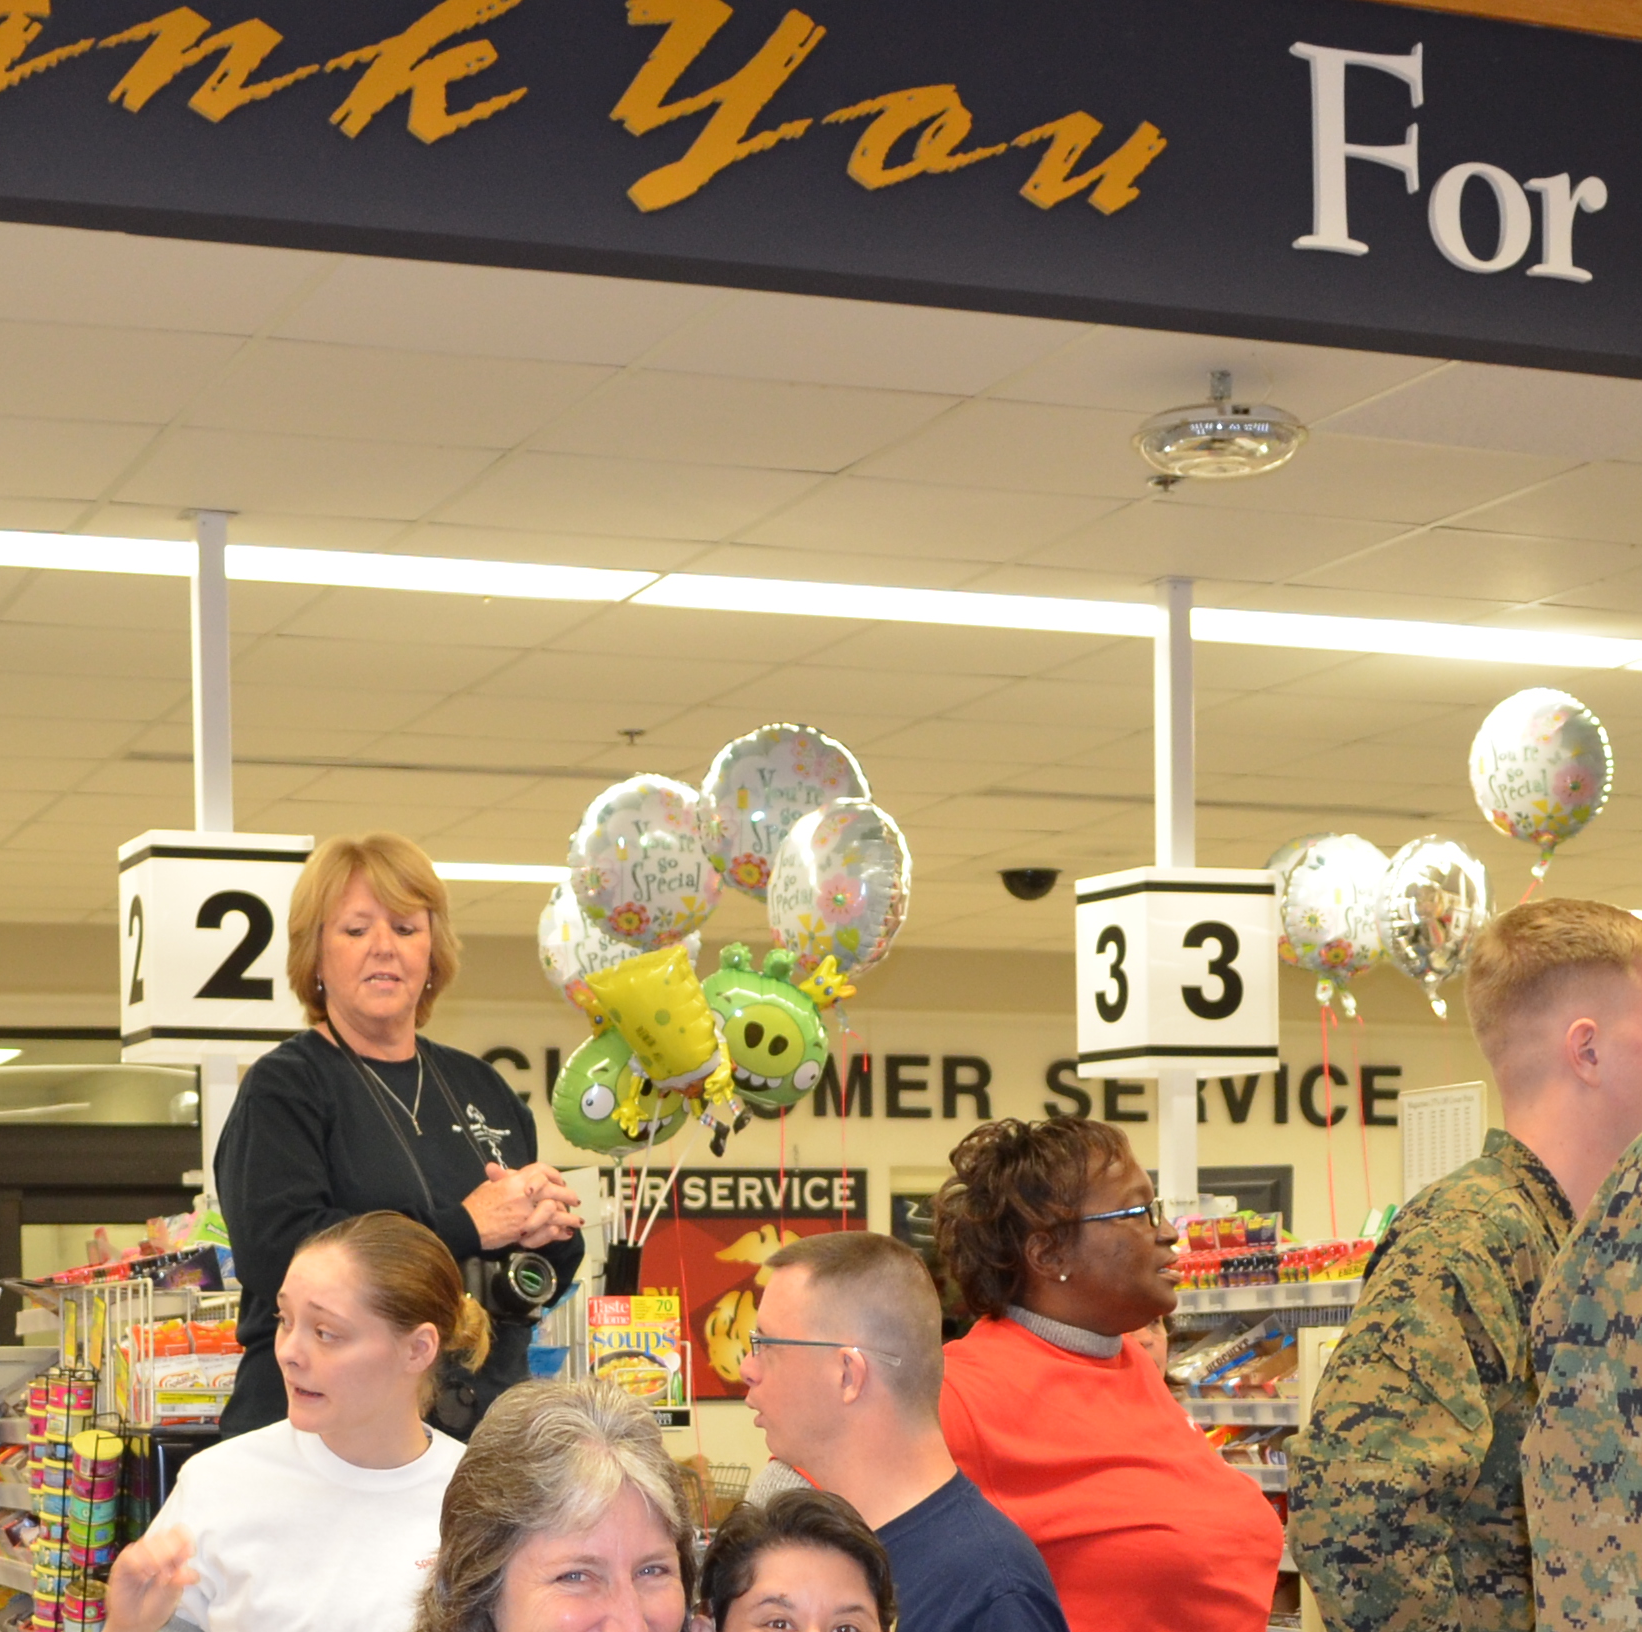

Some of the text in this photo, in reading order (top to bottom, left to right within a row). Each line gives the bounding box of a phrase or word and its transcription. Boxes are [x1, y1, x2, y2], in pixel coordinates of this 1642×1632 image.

[609, 0, 1168, 214] You
[1288, 41, 1609, 283] For
[632, 862, 701, 902] Special
[128, 894, 144, 1006] 2
[193, 889, 274, 1001] 2
[575, 945, 647, 978] Specia
[1181, 920, 1244, 1020] 3
[1095, 924, 1128, 1023] 3
[1043, 1060, 1402, 1128] SEVICE
[683, 1177, 856, 1210] SERVICE
[589, 1299, 630, 1314] Taste
[656, 1299, 673, 1312] 70
[597, 1315, 630, 1325] Home
[592, 1331, 677, 1356] soups
